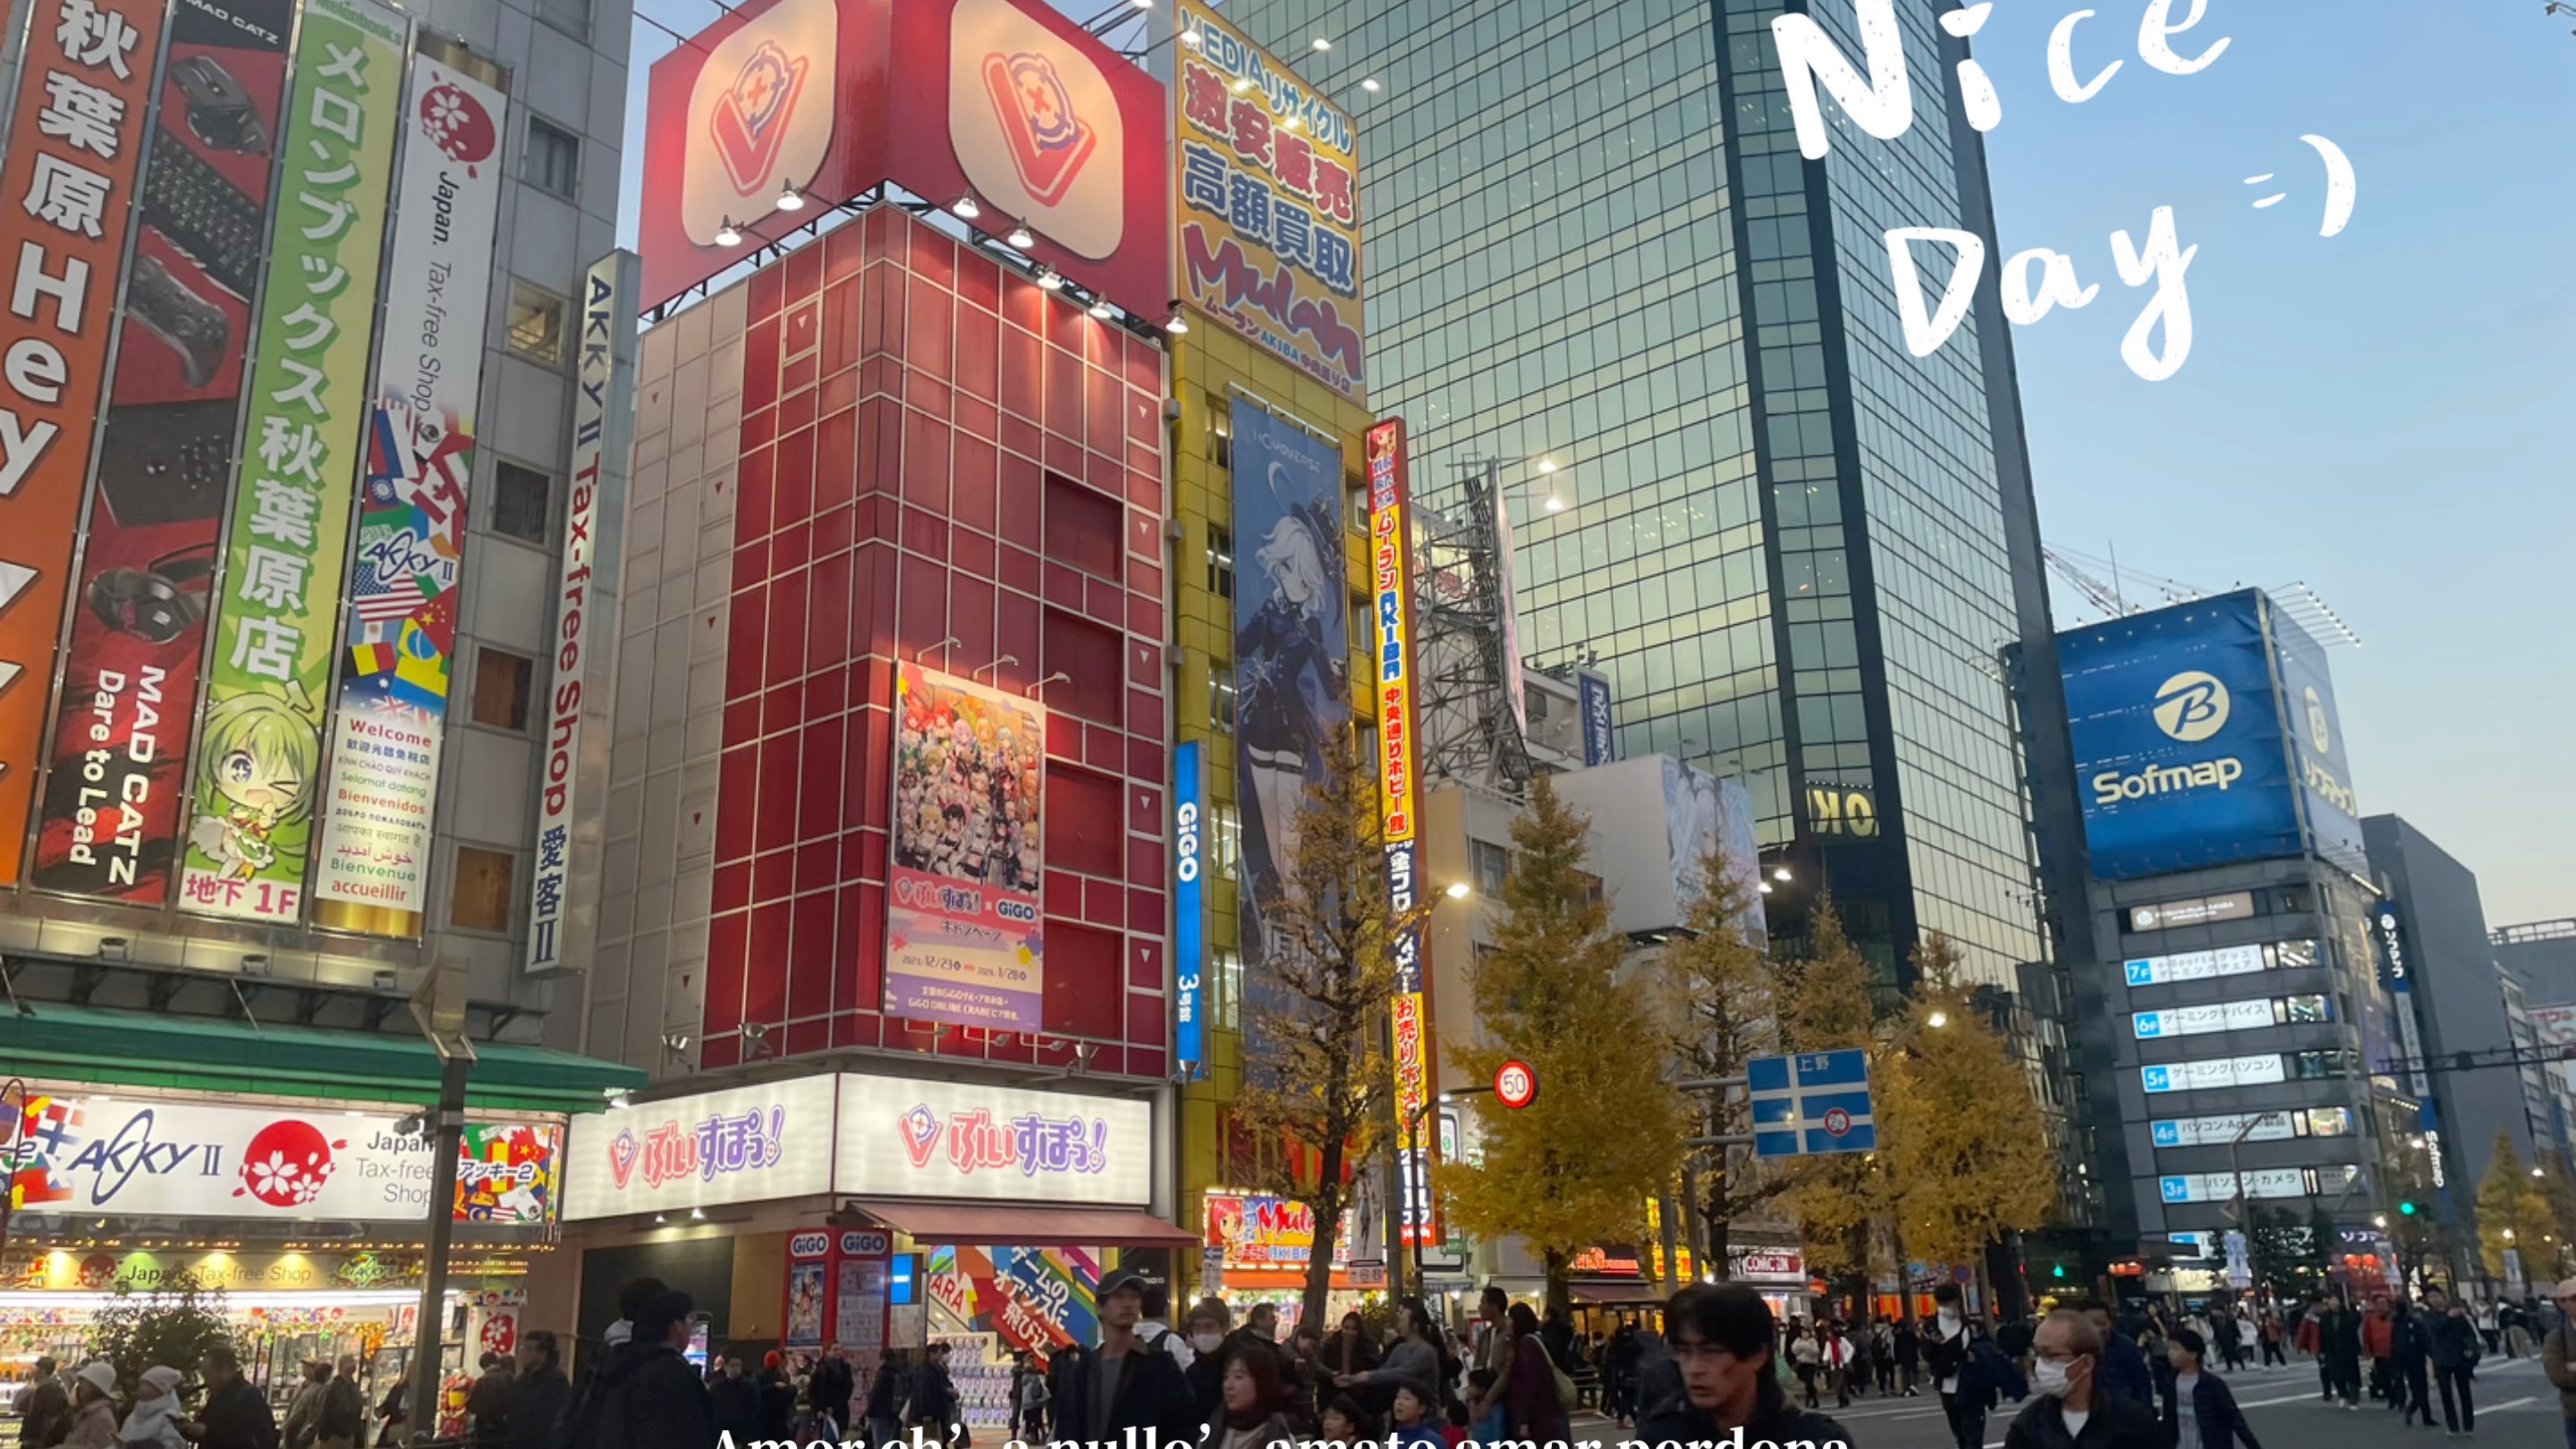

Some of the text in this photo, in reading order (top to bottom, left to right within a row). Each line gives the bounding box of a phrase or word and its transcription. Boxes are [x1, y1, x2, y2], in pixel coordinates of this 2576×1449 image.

[232, 16, 279, 44] CATZ
[1180, 8, 1352, 153] MEDIAリサイクル
[1183, 61, 1352, 223] 激安販売
[1183, 143, 1353, 290] 高額買取
[415, 171, 460, 413] Japan. Tax-free Shop
[1182, 223, 1364, 383] Mulan
[1204, 294, 1260, 335] ムーラン
[1260, 330, 1300, 362] AKIBA
[230, 40, 370, 681] メロンブックス秋葉原店
[560, 451, 600, 679] Tax-free
[1376, 512, 1397, 592] ムーラン
[1379, 591, 1402, 682] AKIBA
[350, 719, 432, 748] Welcome
[545, 688, 580, 816] Shop
[69, 669, 125, 866] Dare to Lead
[108, 665, 166, 886] MAD CATZ
[341, 772, 427, 798] Selamat datang
[2092, 757, 2243, 805] Sofmap
[337, 789, 426, 815] Bienvenidos
[1178, 801, 1199, 882] GiGO
[330, 858, 416, 882] Bienvenue
[332, 879, 408, 902] accueillir
[185, 874, 298, 916] 地下 1F
[997, 899, 1035, 921] GiGO
[2129, 965, 2150, 979] 7F
[2138, 1016, 2157, 1032] 6F
[1504, 1074, 1526, 1095] 50
[2148, 1071, 2168, 1086] 5F
[2157, 1125, 2176, 1140] 4F
[2425, 1130, 2445, 1188] Sofmap
[2165, 1182, 2185, 1196] 3F
[2207, 1173, 2297, 1188] パソン・カメラ
[793, 1235, 826, 1254] GiGO
[843, 1234, 886, 1251] GiGO
[199, 1265, 266, 1282] Tax-free
[270, 1265, 311, 1284] Shop
